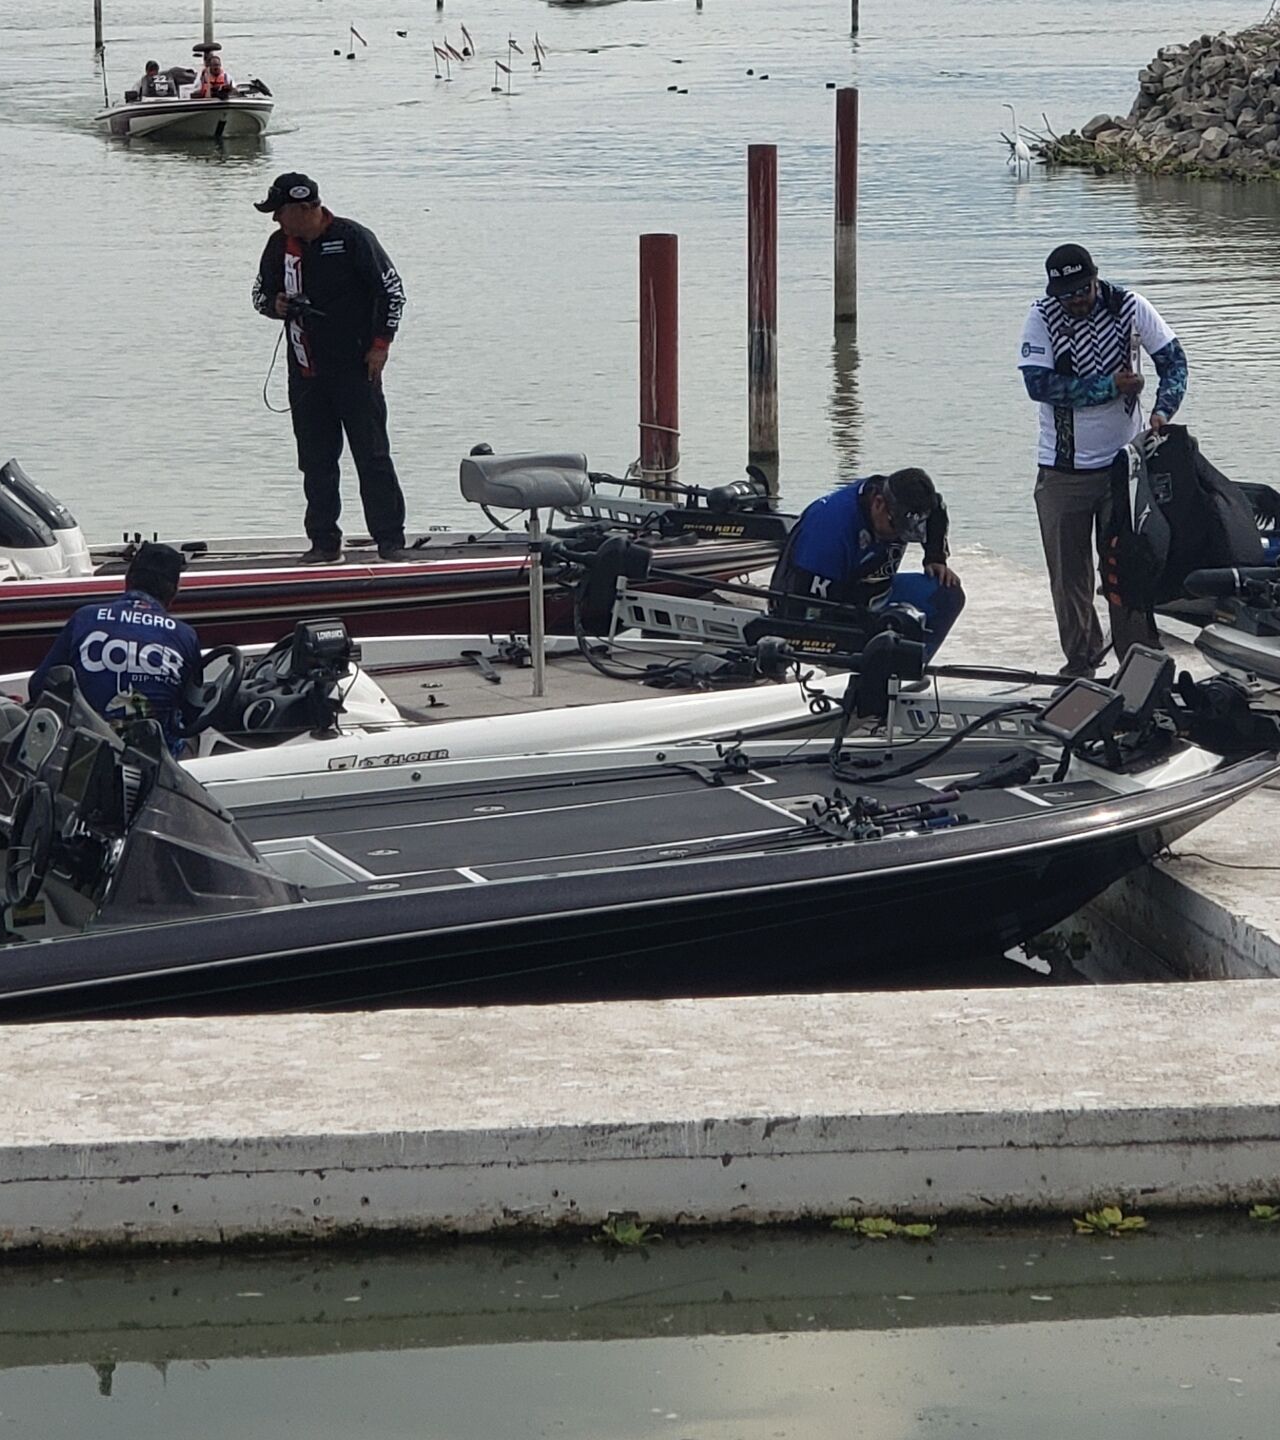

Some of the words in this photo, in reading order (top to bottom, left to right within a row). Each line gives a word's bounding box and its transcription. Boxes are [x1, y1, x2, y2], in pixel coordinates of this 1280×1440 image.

[97, 608, 116, 620] EL
[120, 610, 176, 630] NEGRO
[80, 631, 184, 679] COLOR
